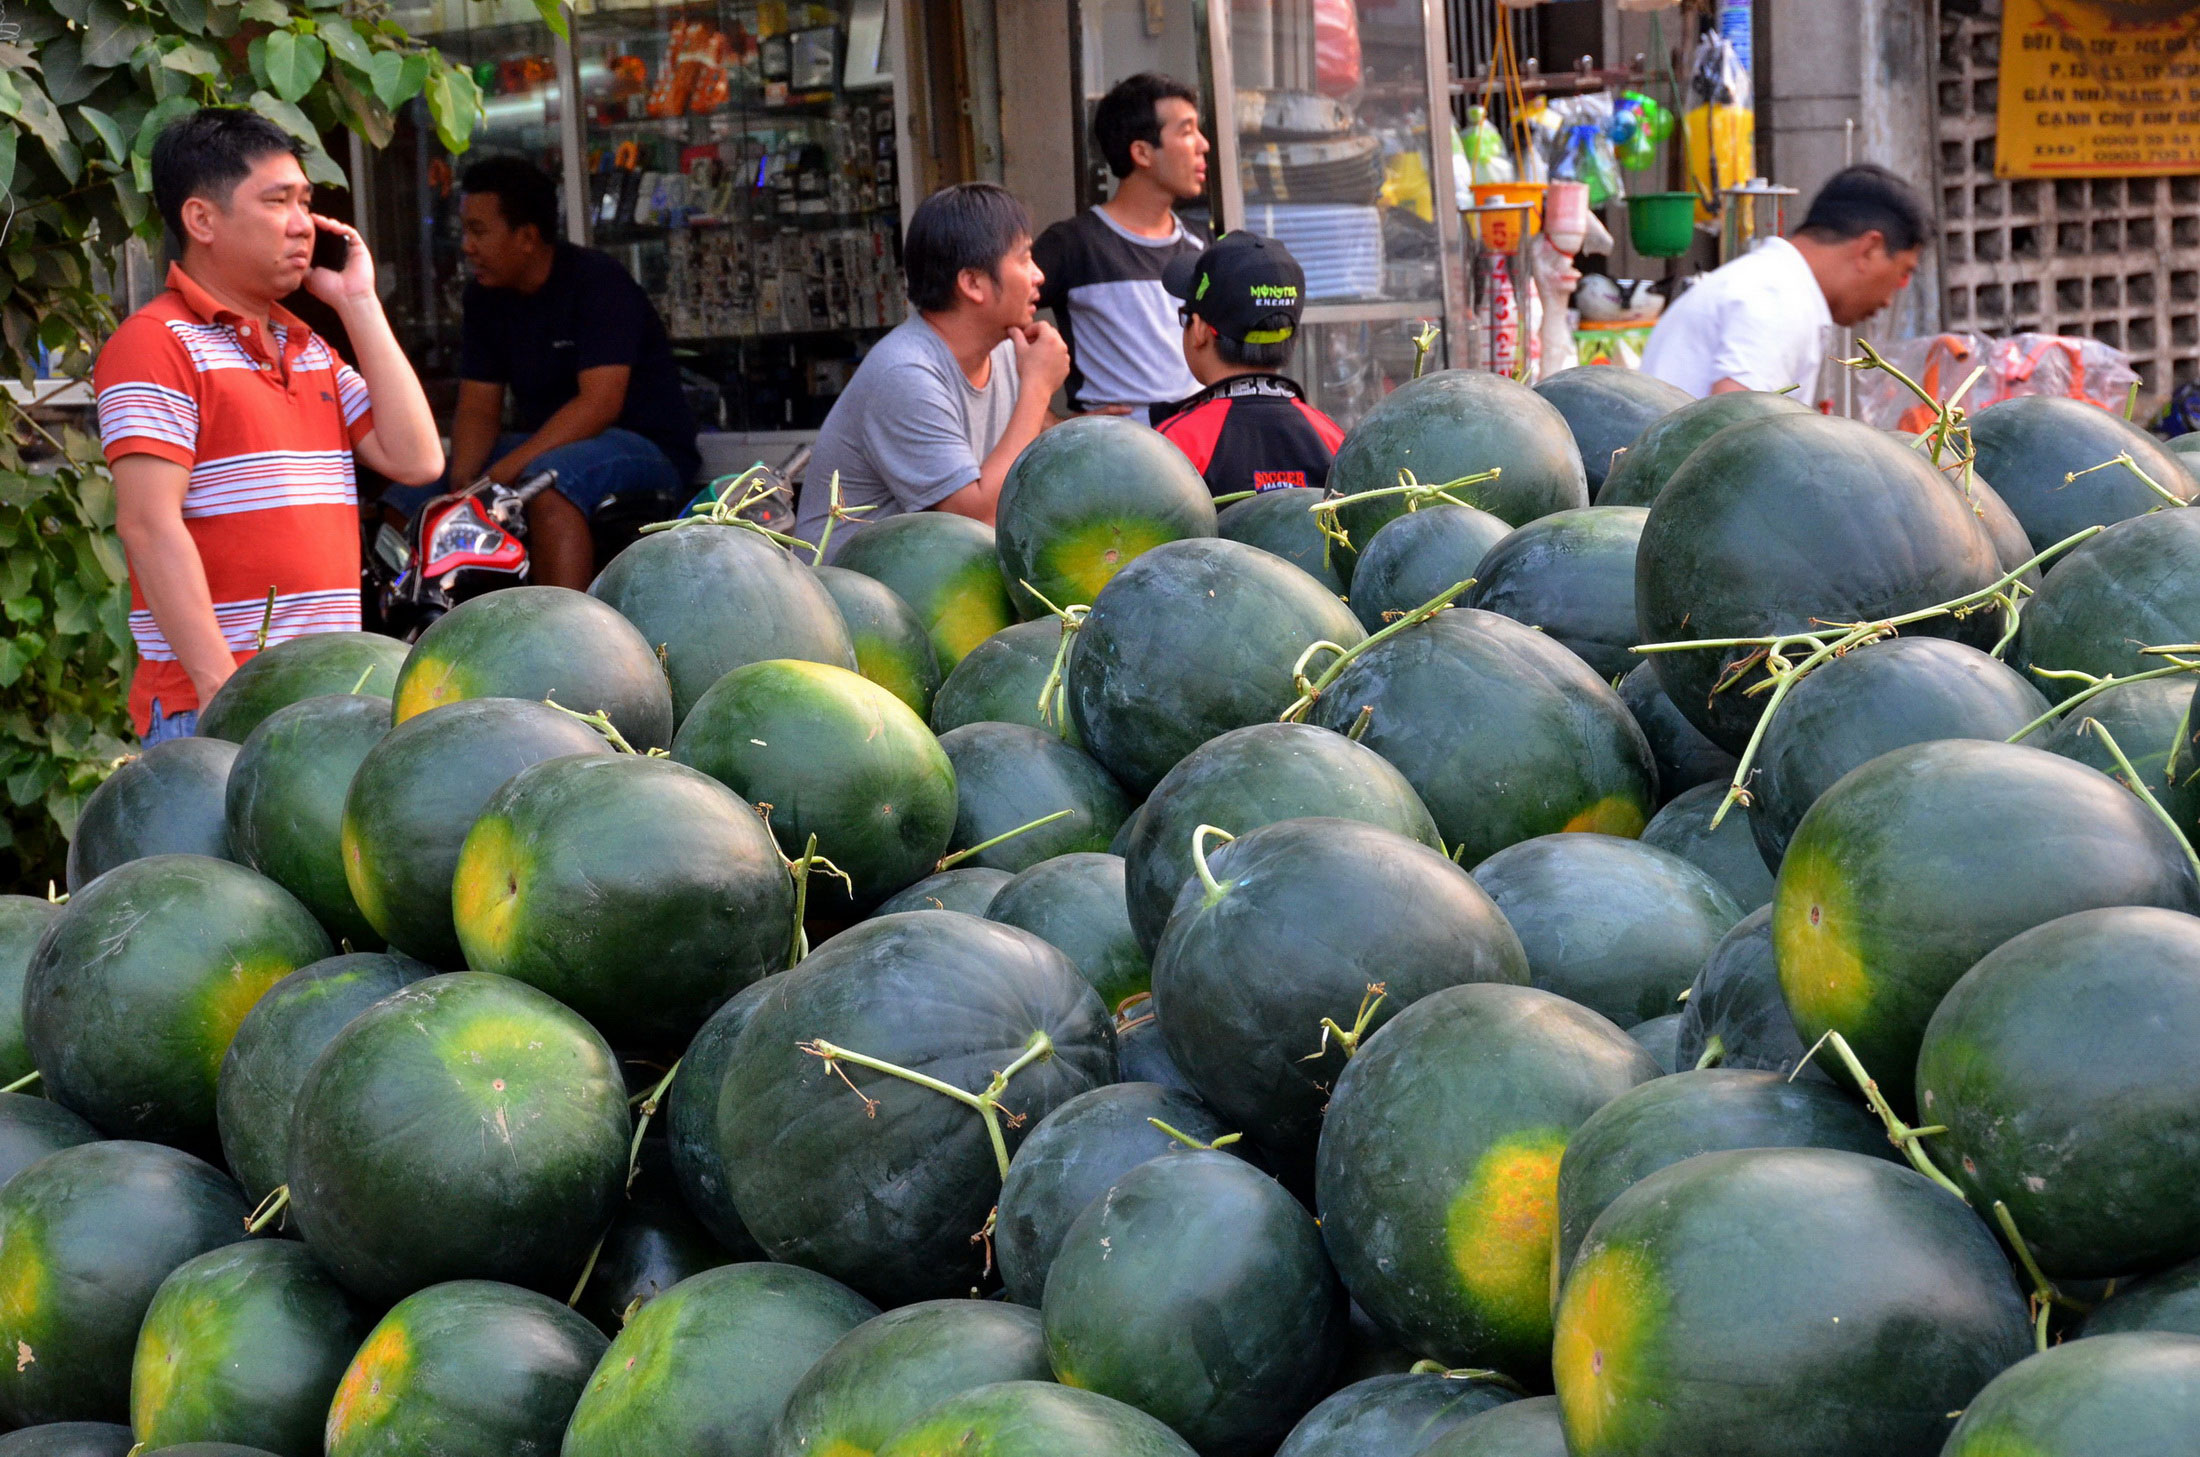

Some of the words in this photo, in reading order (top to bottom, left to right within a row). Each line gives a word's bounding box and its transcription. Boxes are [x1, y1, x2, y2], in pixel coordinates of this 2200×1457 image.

[1250, 284, 1298, 299] MONSTER
[1255, 298, 1296, 307] ENERGY
[1254, 471, 1307, 490] SOCCER
